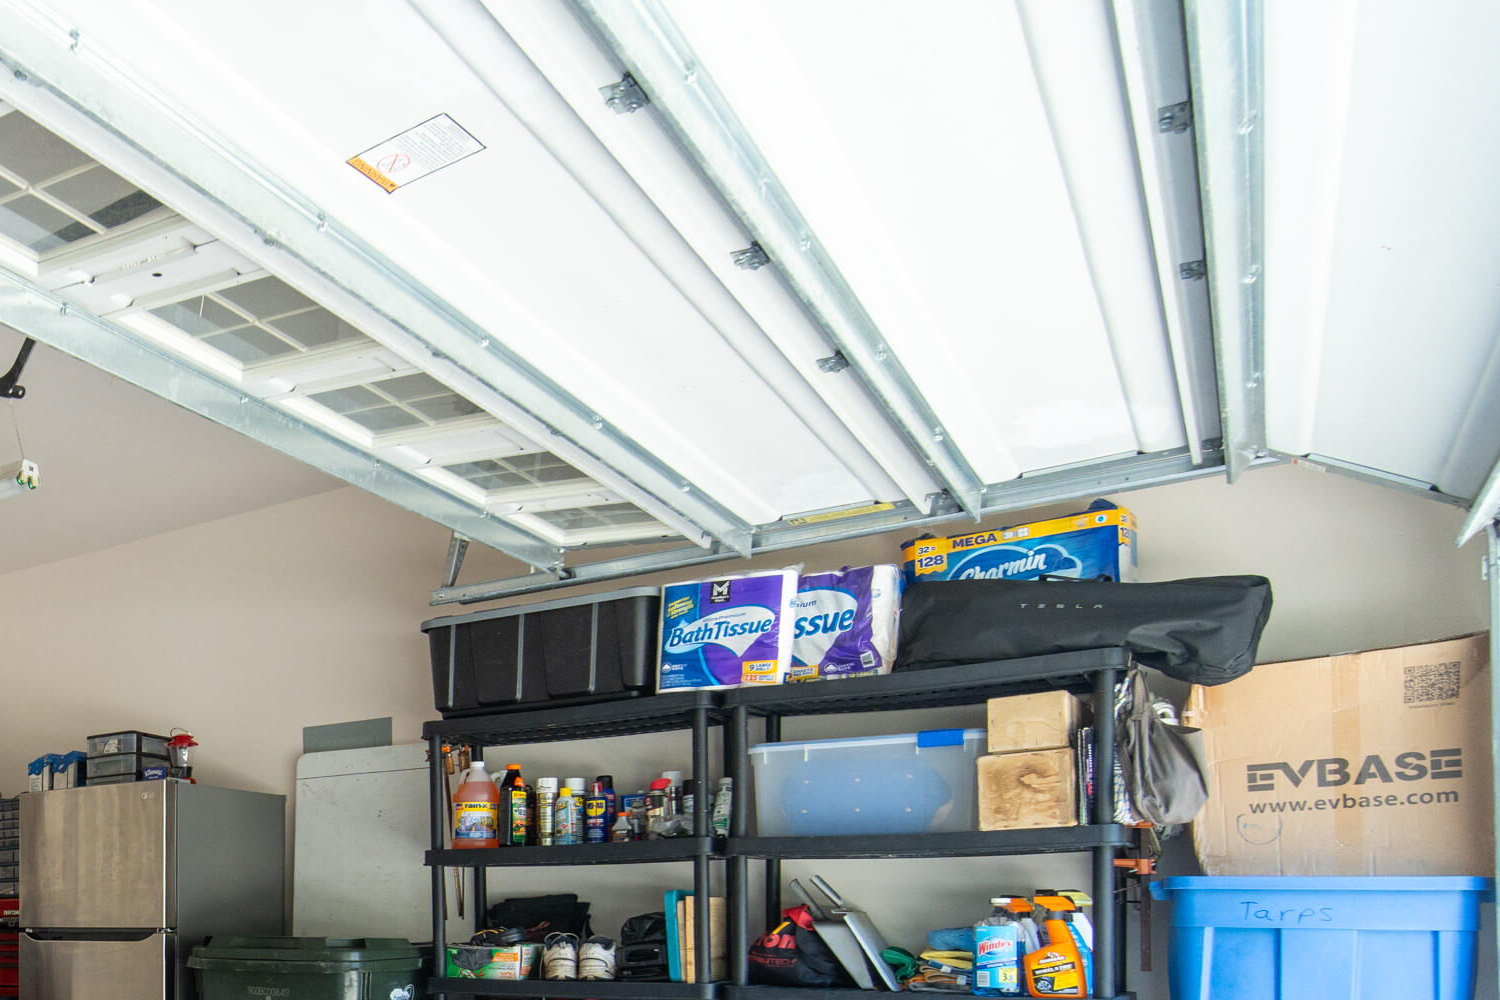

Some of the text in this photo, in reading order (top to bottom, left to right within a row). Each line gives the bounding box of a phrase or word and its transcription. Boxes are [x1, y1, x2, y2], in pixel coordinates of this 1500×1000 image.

[952, 532, 998, 549] MEGA
[918, 546, 929, 555] 32
[917, 554, 945, 569] 128
[961, 551, 1048, 580] Charmin
[1246, 747, 1463, 792] EVBASE
[1249, 787, 1460, 814] www.evbase.com
[1240, 901, 1332, 923] Tarps
[978, 940, 1013, 957] Windex
